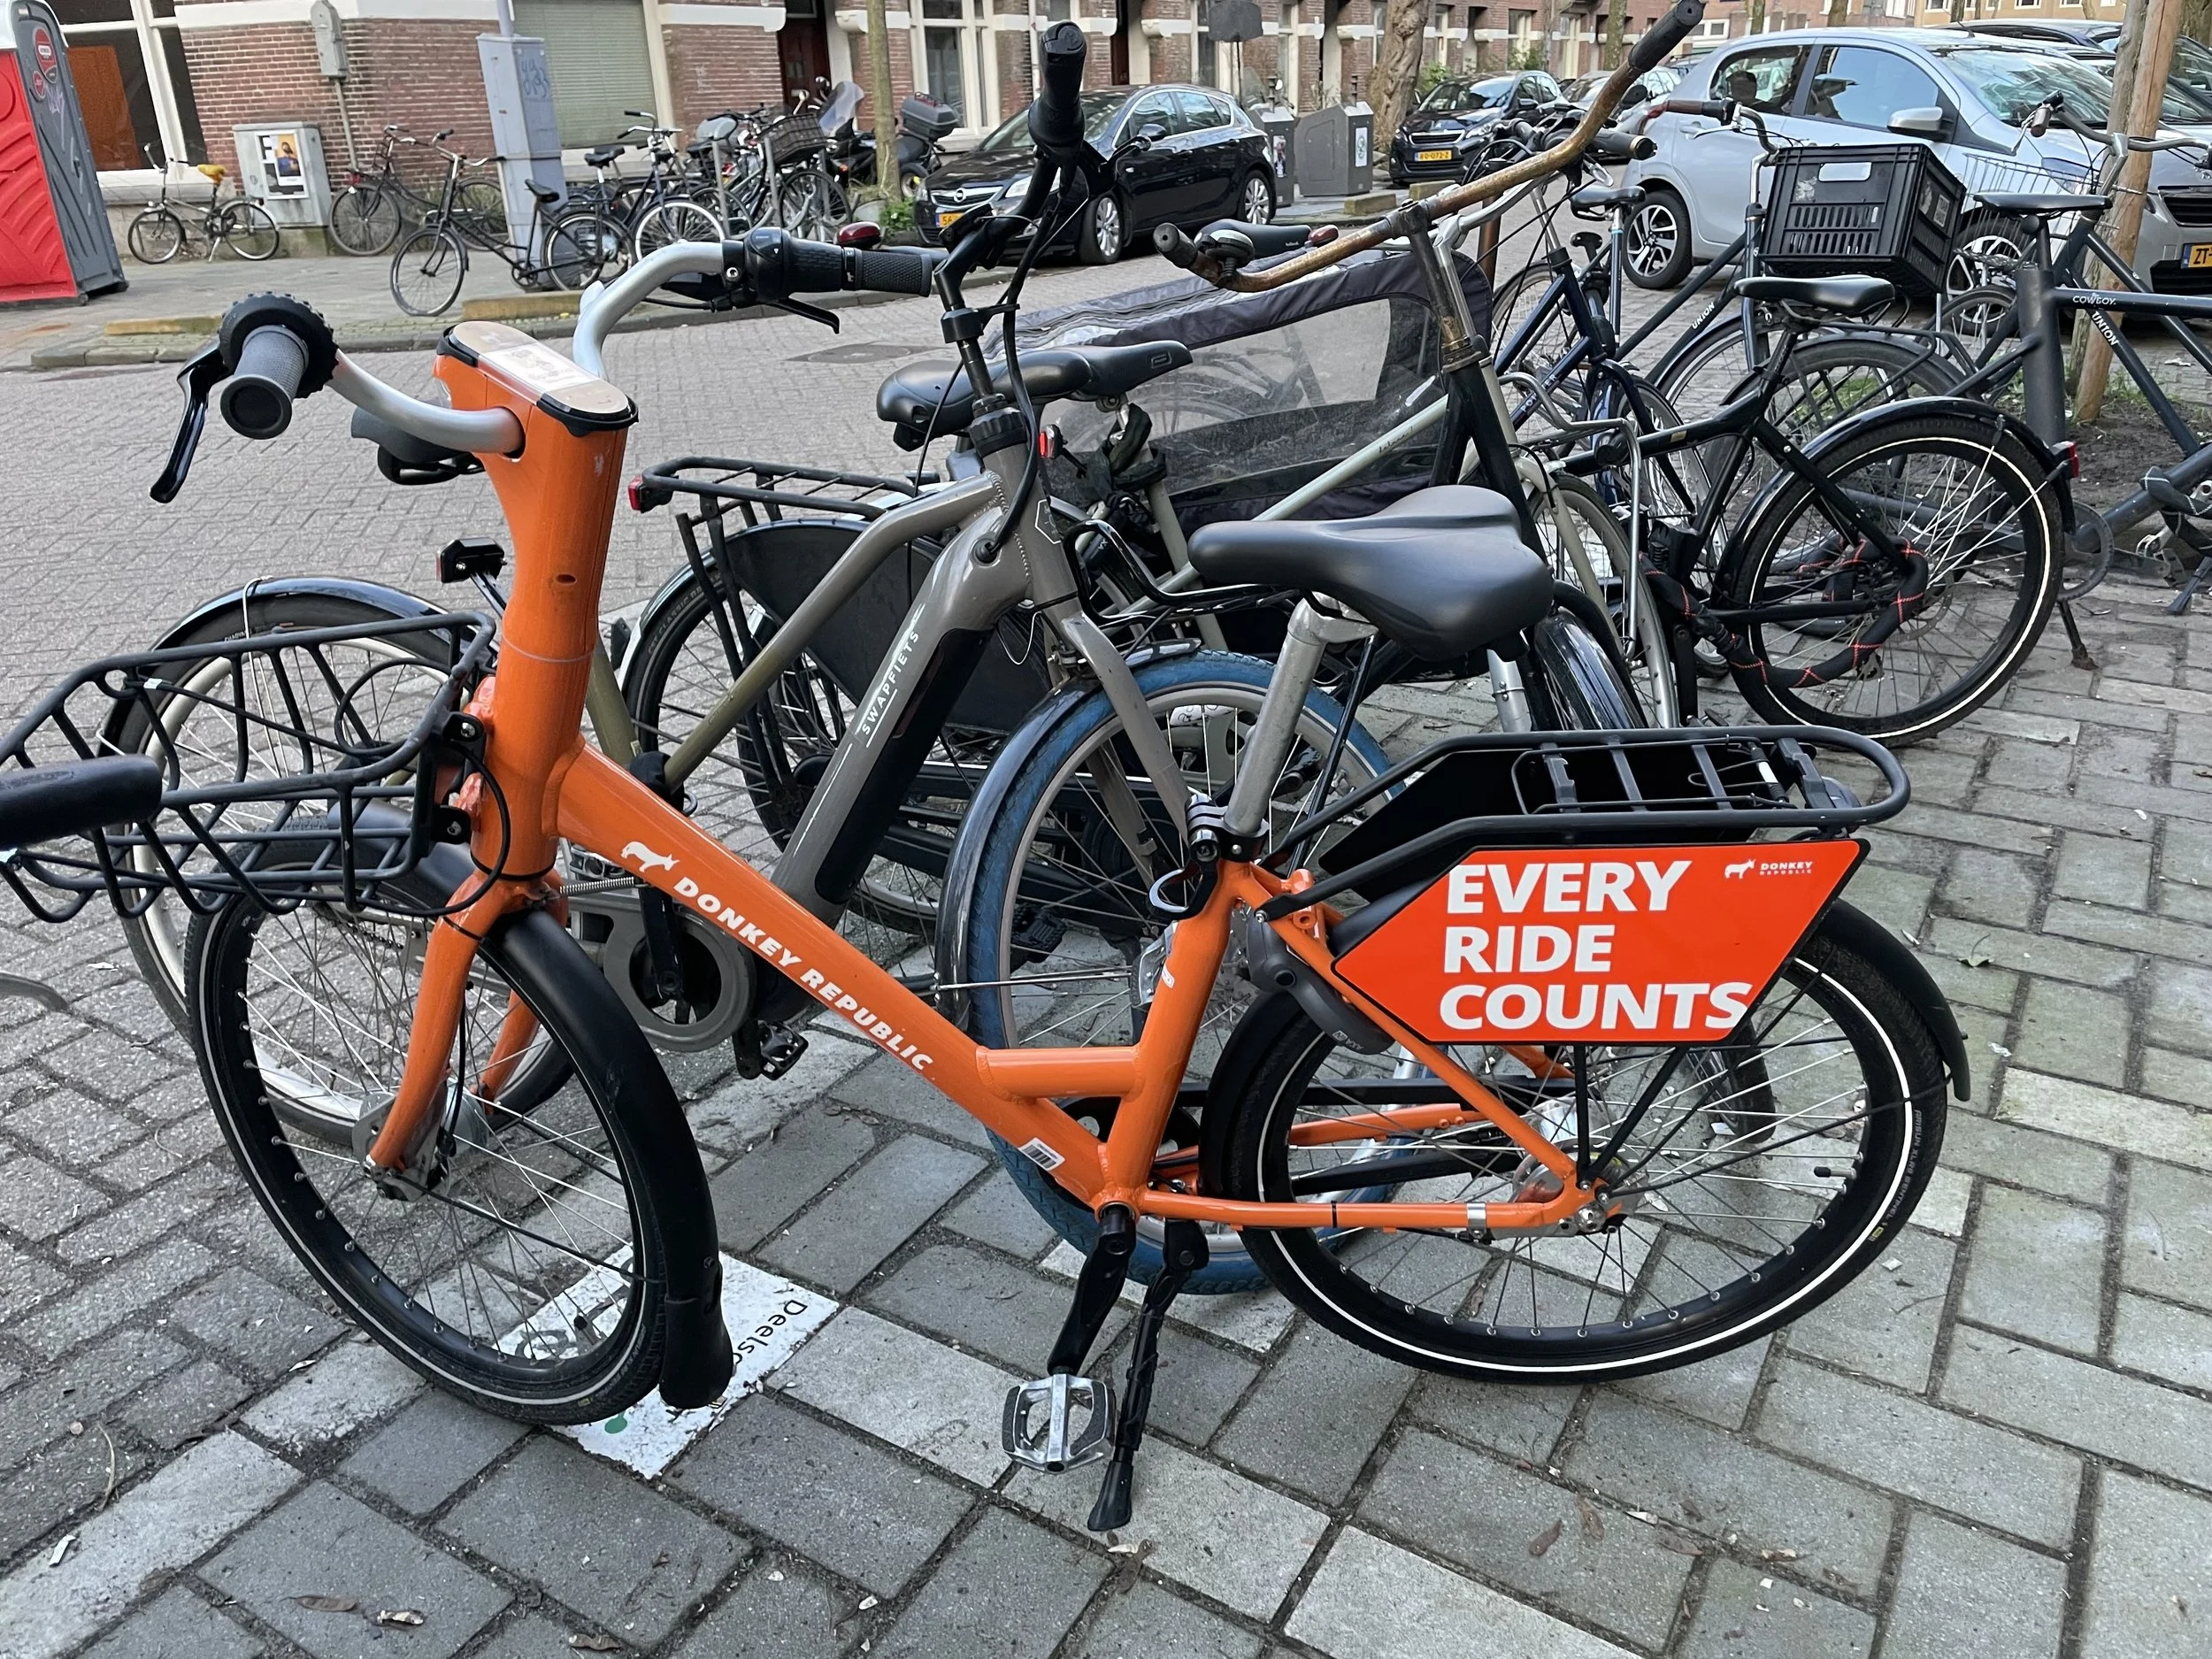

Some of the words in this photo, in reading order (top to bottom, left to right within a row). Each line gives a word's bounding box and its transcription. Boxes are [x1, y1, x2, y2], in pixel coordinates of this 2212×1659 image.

[2193, 247, 2212, 265] ZT-
[1691, 302, 1715, 329] UNION
[2092, 311, 2120, 346] UNION
[862, 631, 919, 736] SWAPFIETS
[1447, 860, 1692, 914] EVERY
[1760, 861, 1813, 871] DONKEY
[1443, 925, 1615, 973] RIDE
[673, 876, 803, 968] DONKEY
[800, 968, 933, 1071] REPUBLIC
[1440, 981, 1753, 1030] COUNTS
